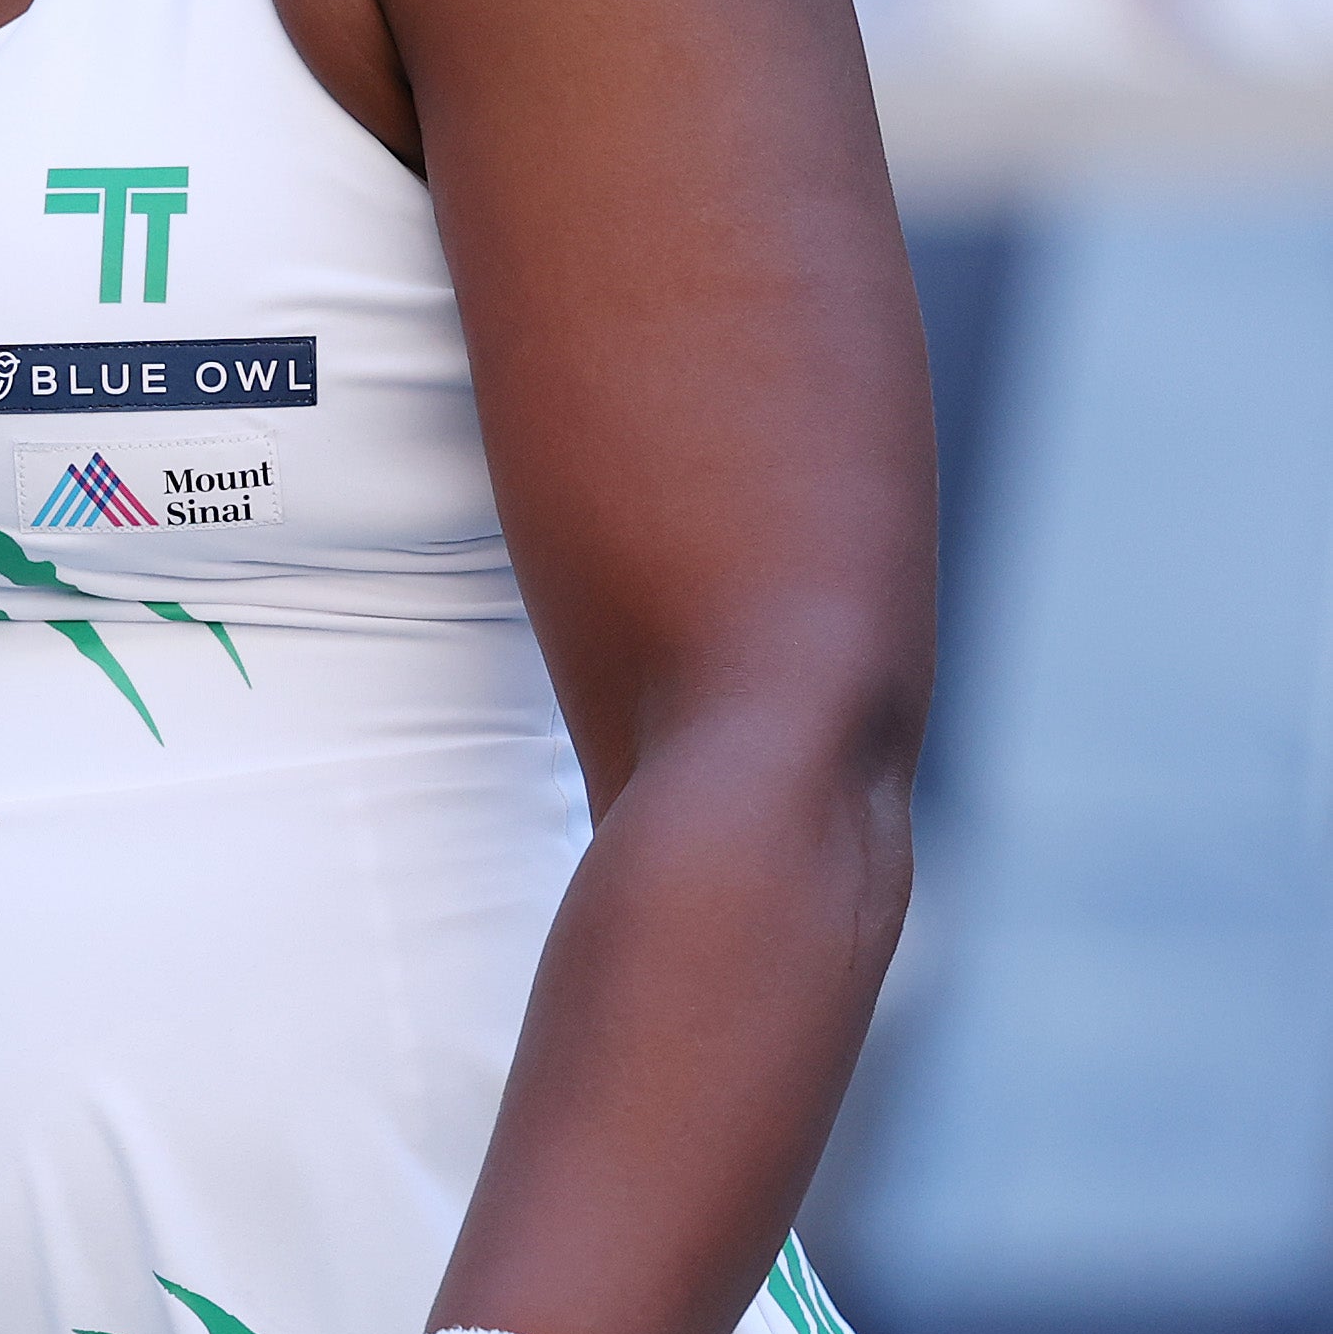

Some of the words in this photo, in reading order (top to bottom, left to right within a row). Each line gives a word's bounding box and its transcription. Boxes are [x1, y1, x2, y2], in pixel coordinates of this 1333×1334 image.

[31, 362, 167, 396] BLUE
[194, 359, 312, 394] OWL
[163, 461, 274, 495] Mount
[166, 493, 254, 527] Sinai
